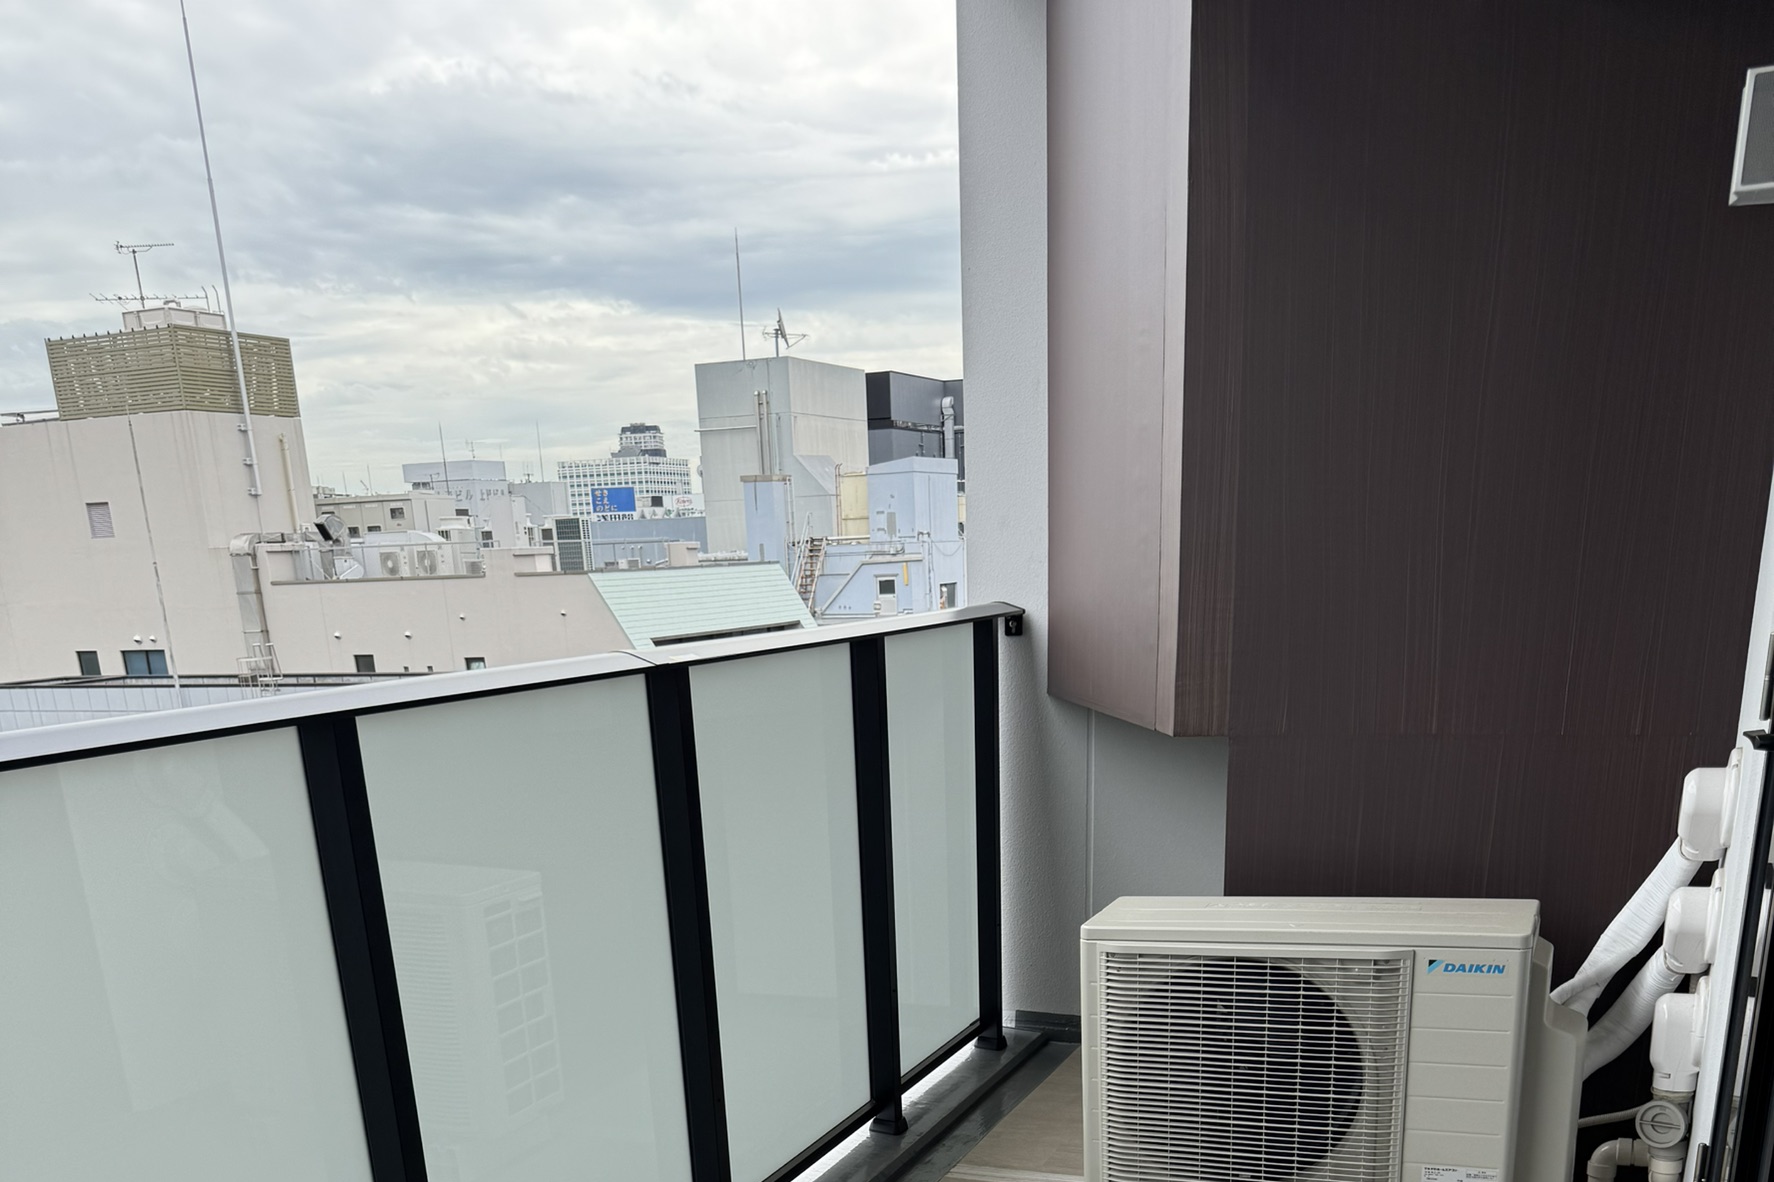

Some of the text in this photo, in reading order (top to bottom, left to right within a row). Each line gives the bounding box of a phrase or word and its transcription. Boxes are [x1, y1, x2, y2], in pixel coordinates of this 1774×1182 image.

[596, 504, 618, 512] のどに
[1443, 963, 1506, 975] DAIKIN
